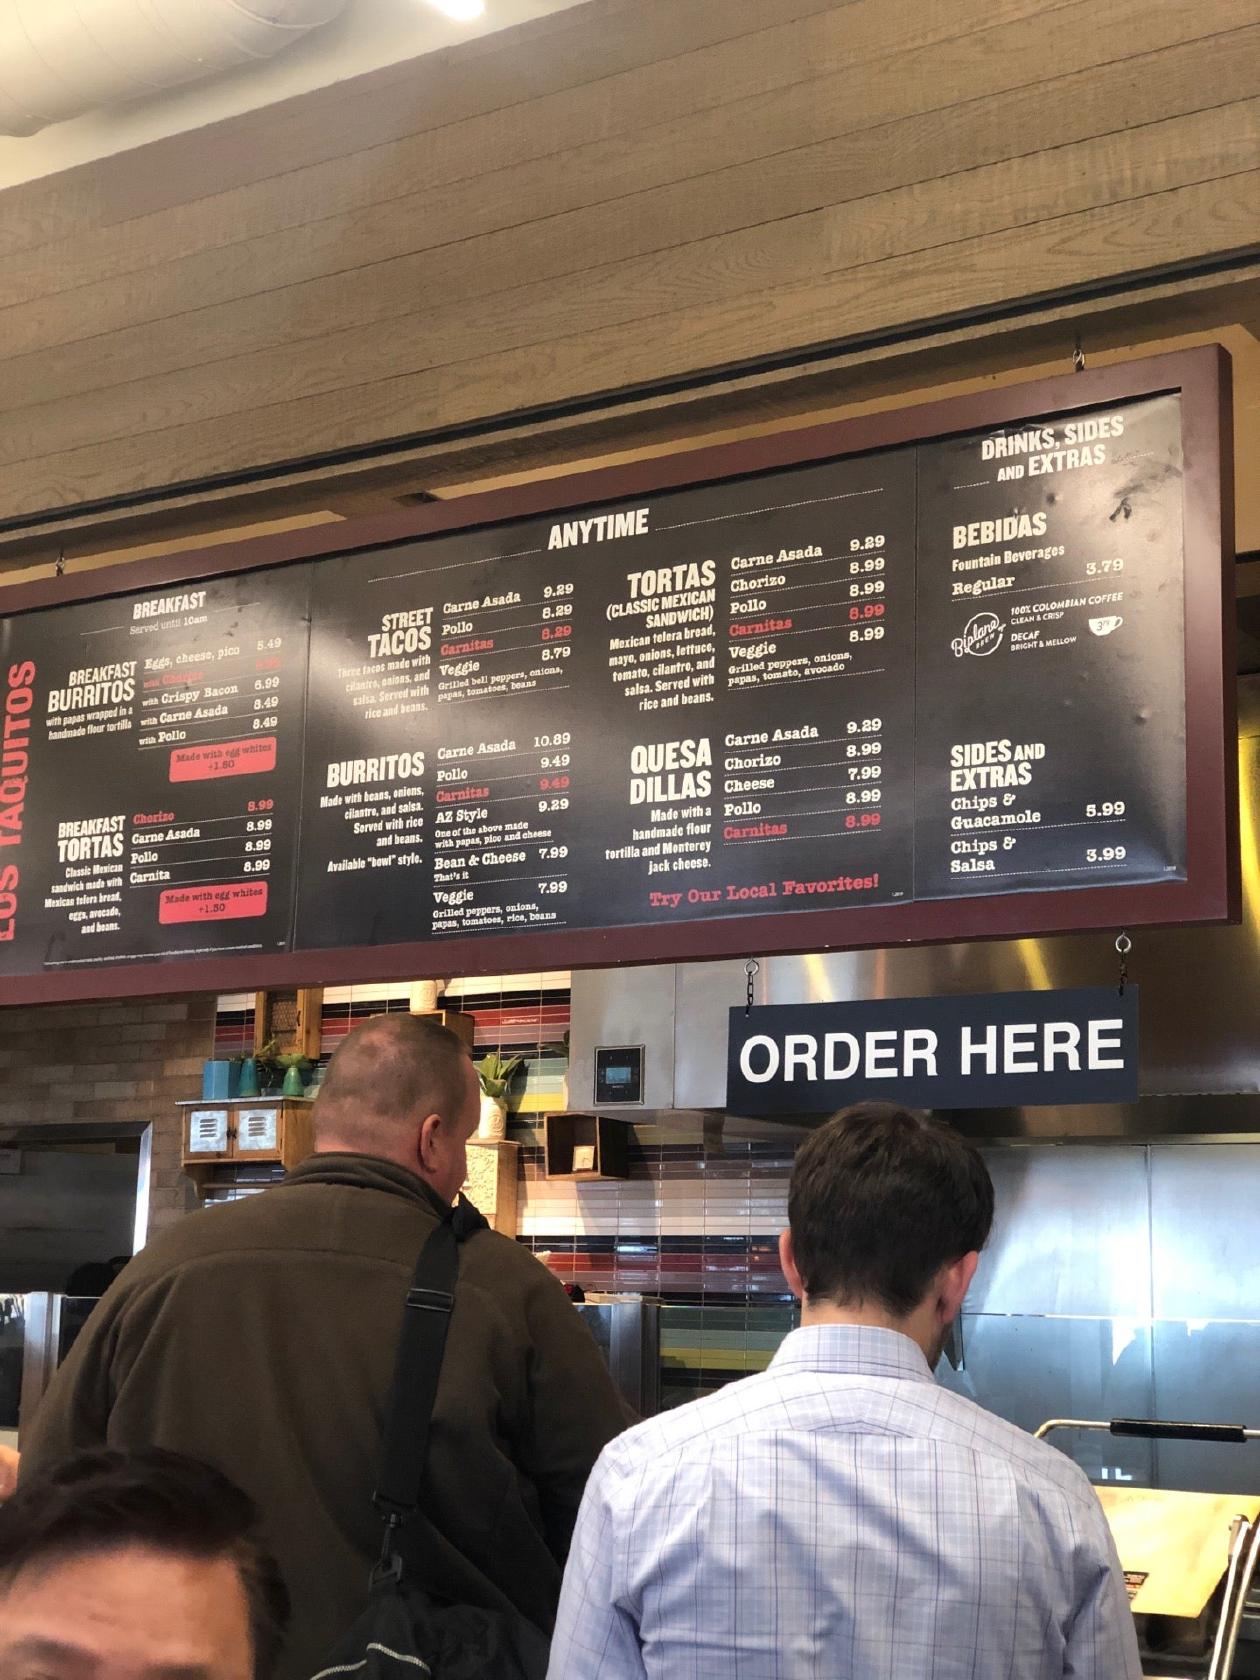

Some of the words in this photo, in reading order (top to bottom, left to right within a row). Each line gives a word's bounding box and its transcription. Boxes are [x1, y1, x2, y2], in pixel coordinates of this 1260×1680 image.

[981, 429, 1061, 461] DRINKS,
[1064, 415, 1125, 446] SIDES
[997, 464, 1024, 482] AND
[1028, 444, 1106, 476] EXTRAS
[547, 508, 649, 550] ANYTIME
[953, 512, 1047, 550] BEBIDAS
[731, 553, 773, 570] Carne
[776, 545, 823, 563] Asada
[850, 534, 885, 552] 9.29
[952, 553, 1001, 572] Fountain
[1004, 545, 1065, 564] Beverages
[627, 560, 716, 599] TORTAS
[730, 573, 786, 592] Chorizo
[849, 557, 885, 574] 8.99
[951, 575, 1015, 596] Regular
[1086, 558, 1124, 575] 3.79
[133, 591, 206, 620] BREAKFAST
[443, 600, 479, 614] Carne
[481, 592, 521, 608] Asada
[543, 583, 574, 598] 9.29
[606, 597, 660, 621] (CLASSIC
[661, 588, 716, 610] MEXICAN
[730, 599, 767, 614] Pollo
[849, 580, 885, 597] 8.99
[1011, 605, 1031, 616] 100%
[1032, 598, 1086, 612] COLOMBIAN
[1088, 592, 1123, 605] COFFEE
[183, 614, 208, 627] 10am
[381, 606, 434, 632] STREET
[442, 621, 473, 636] Pollo
[542, 604, 573, 619] 8.29
[646, 604, 714, 629] SANDWICH)
[729, 617, 793, 637] Carnitas
[849, 604, 885, 620] 8.99
[1011, 616, 1034, 625] CLEAN
[1042, 611, 1064, 621] CRISP
[367, 625, 432, 658] TACOS
[441, 639, 494, 656] Carnitas
[541, 625, 572, 640] 8.29
[609, 634, 651, 651] Mexican
[653, 629, 682, 644] telera
[684, 624, 716, 640] bread,
[729, 642, 777, 660] Veggie
[849, 626, 884, 642] 8.99
[1010, 641, 1037, 651] BRIGHT
[1045, 636, 1077, 647] MELLOW
[1011, 631, 1040, 642] DECAF
[145, 657, 172, 670] Eggs,
[176, 651, 214, 664] cheese,
[218, 646, 240, 660] pico
[439, 660, 480, 677] Veggie
[541, 646, 571, 661] 8.79
[609, 652, 637, 667] mayo,
[639, 647, 674, 661] onions,
[676, 641, 716, 657] lettuce,
[69, 660, 137, 687] BREAKFAST
[47, 678, 135, 713] BURRITOS
[142, 697, 158, 707] with
[161, 690, 200, 704] Crispy
[204, 685, 239, 698] Bacon
[254, 676, 280, 690] 6.99
[141, 717, 158, 726] with
[160, 710, 192, 723] Carne
[194, 705, 228, 719] Asada
[254, 696, 279, 710] 8.49
[139, 735, 156, 746] with
[158, 730, 186, 743] Pollo
[253, 716, 278, 729] 8.49
[725, 732, 769, 747] Carne
[772, 726, 819, 741] Asada
[846, 717, 882, 734] 9.29
[437, 744, 474, 760] Carne
[477, 738, 516, 755] Asada
[534, 732, 571, 748] 10.89
[631, 737, 712, 775] QUESA
[724, 754, 781, 771] Chorizo
[846, 742, 882, 757] 8.99
[950, 739, 1011, 768] SIDES
[1014, 743, 1046, 761] AND
[327, 751, 425, 788] BURRITOS
[436, 768, 468, 782] Pollo
[540, 754, 571, 770] 9.49
[724, 777, 775, 793] Cheese
[848, 766, 882, 780] 7.99
[950, 762, 1032, 792] EXTRAS
[436, 786, 490, 803] Carnitas
[539, 776, 570, 791] 9.49
[630, 770, 712, 805] DILLAS
[247, 799, 274, 811] 8.99
[435, 811, 453, 824] AZ
[456, 808, 488, 824] Style
[538, 798, 569, 812] 9.29
[651, 808, 678, 823] Made
[680, 806, 704, 820] with
[724, 802, 761, 817] Pollo
[846, 789, 881, 804] 8.99
[951, 796, 997, 812] Chips
[1003, 793, 1016, 806] &
[951, 810, 1041, 830] Guacamole
[1086, 801, 1125, 817] 5.99
[58, 815, 125, 839] BREAKFAST
[131, 832, 165, 845] Carne
[166, 827, 200, 840] Asada
[246, 819, 273, 832] 8.99
[632, 825, 684, 841] handmade
[686, 822, 711, 835] flour
[723, 823, 788, 840] Carnitas
[845, 813, 881, 828] 8.99
[57, 833, 124, 863] TORTAS
[130, 851, 158, 865] Pollo
[244, 839, 271, 853] 8.99
[434, 856, 466, 870] Bean
[468, 854, 480, 867] &
[482, 850, 526, 866] Cheese
[538, 846, 569, 860] 7.99
[605, 847, 640, 860] tortilla
[642, 844, 660, 856] and
[662, 841, 711, 855] Monterey
[950, 858, 995, 873] Salsa
[1086, 846, 1126, 862] 3.99
[951, 839, 997, 855] Chips
[1003, 836, 1016, 849] &
[130, 870, 171, 884] Carnita
[243, 860, 271, 873] 8.99
[327, 856, 366, 873] Available
[367, 854, 396, 869] "bowl"
[398, 852, 423, 866] style.
[433, 872, 461, 882] That's
[462, 871, 469, 880] it
[648, 861, 670, 875] jack
[673, 857, 711, 870] cheese.
[433, 890, 474, 906] Veggie
[538, 881, 568, 895] 7.99
[649, 891, 681, 908] Try
[688, 887, 721, 904] Our
[727, 882, 777, 900] Local
[783, 873, 880, 896] Favorites!
[739, 1028, 938, 1085] ORDER
[960, 1018, 1125, 1076] HERE
